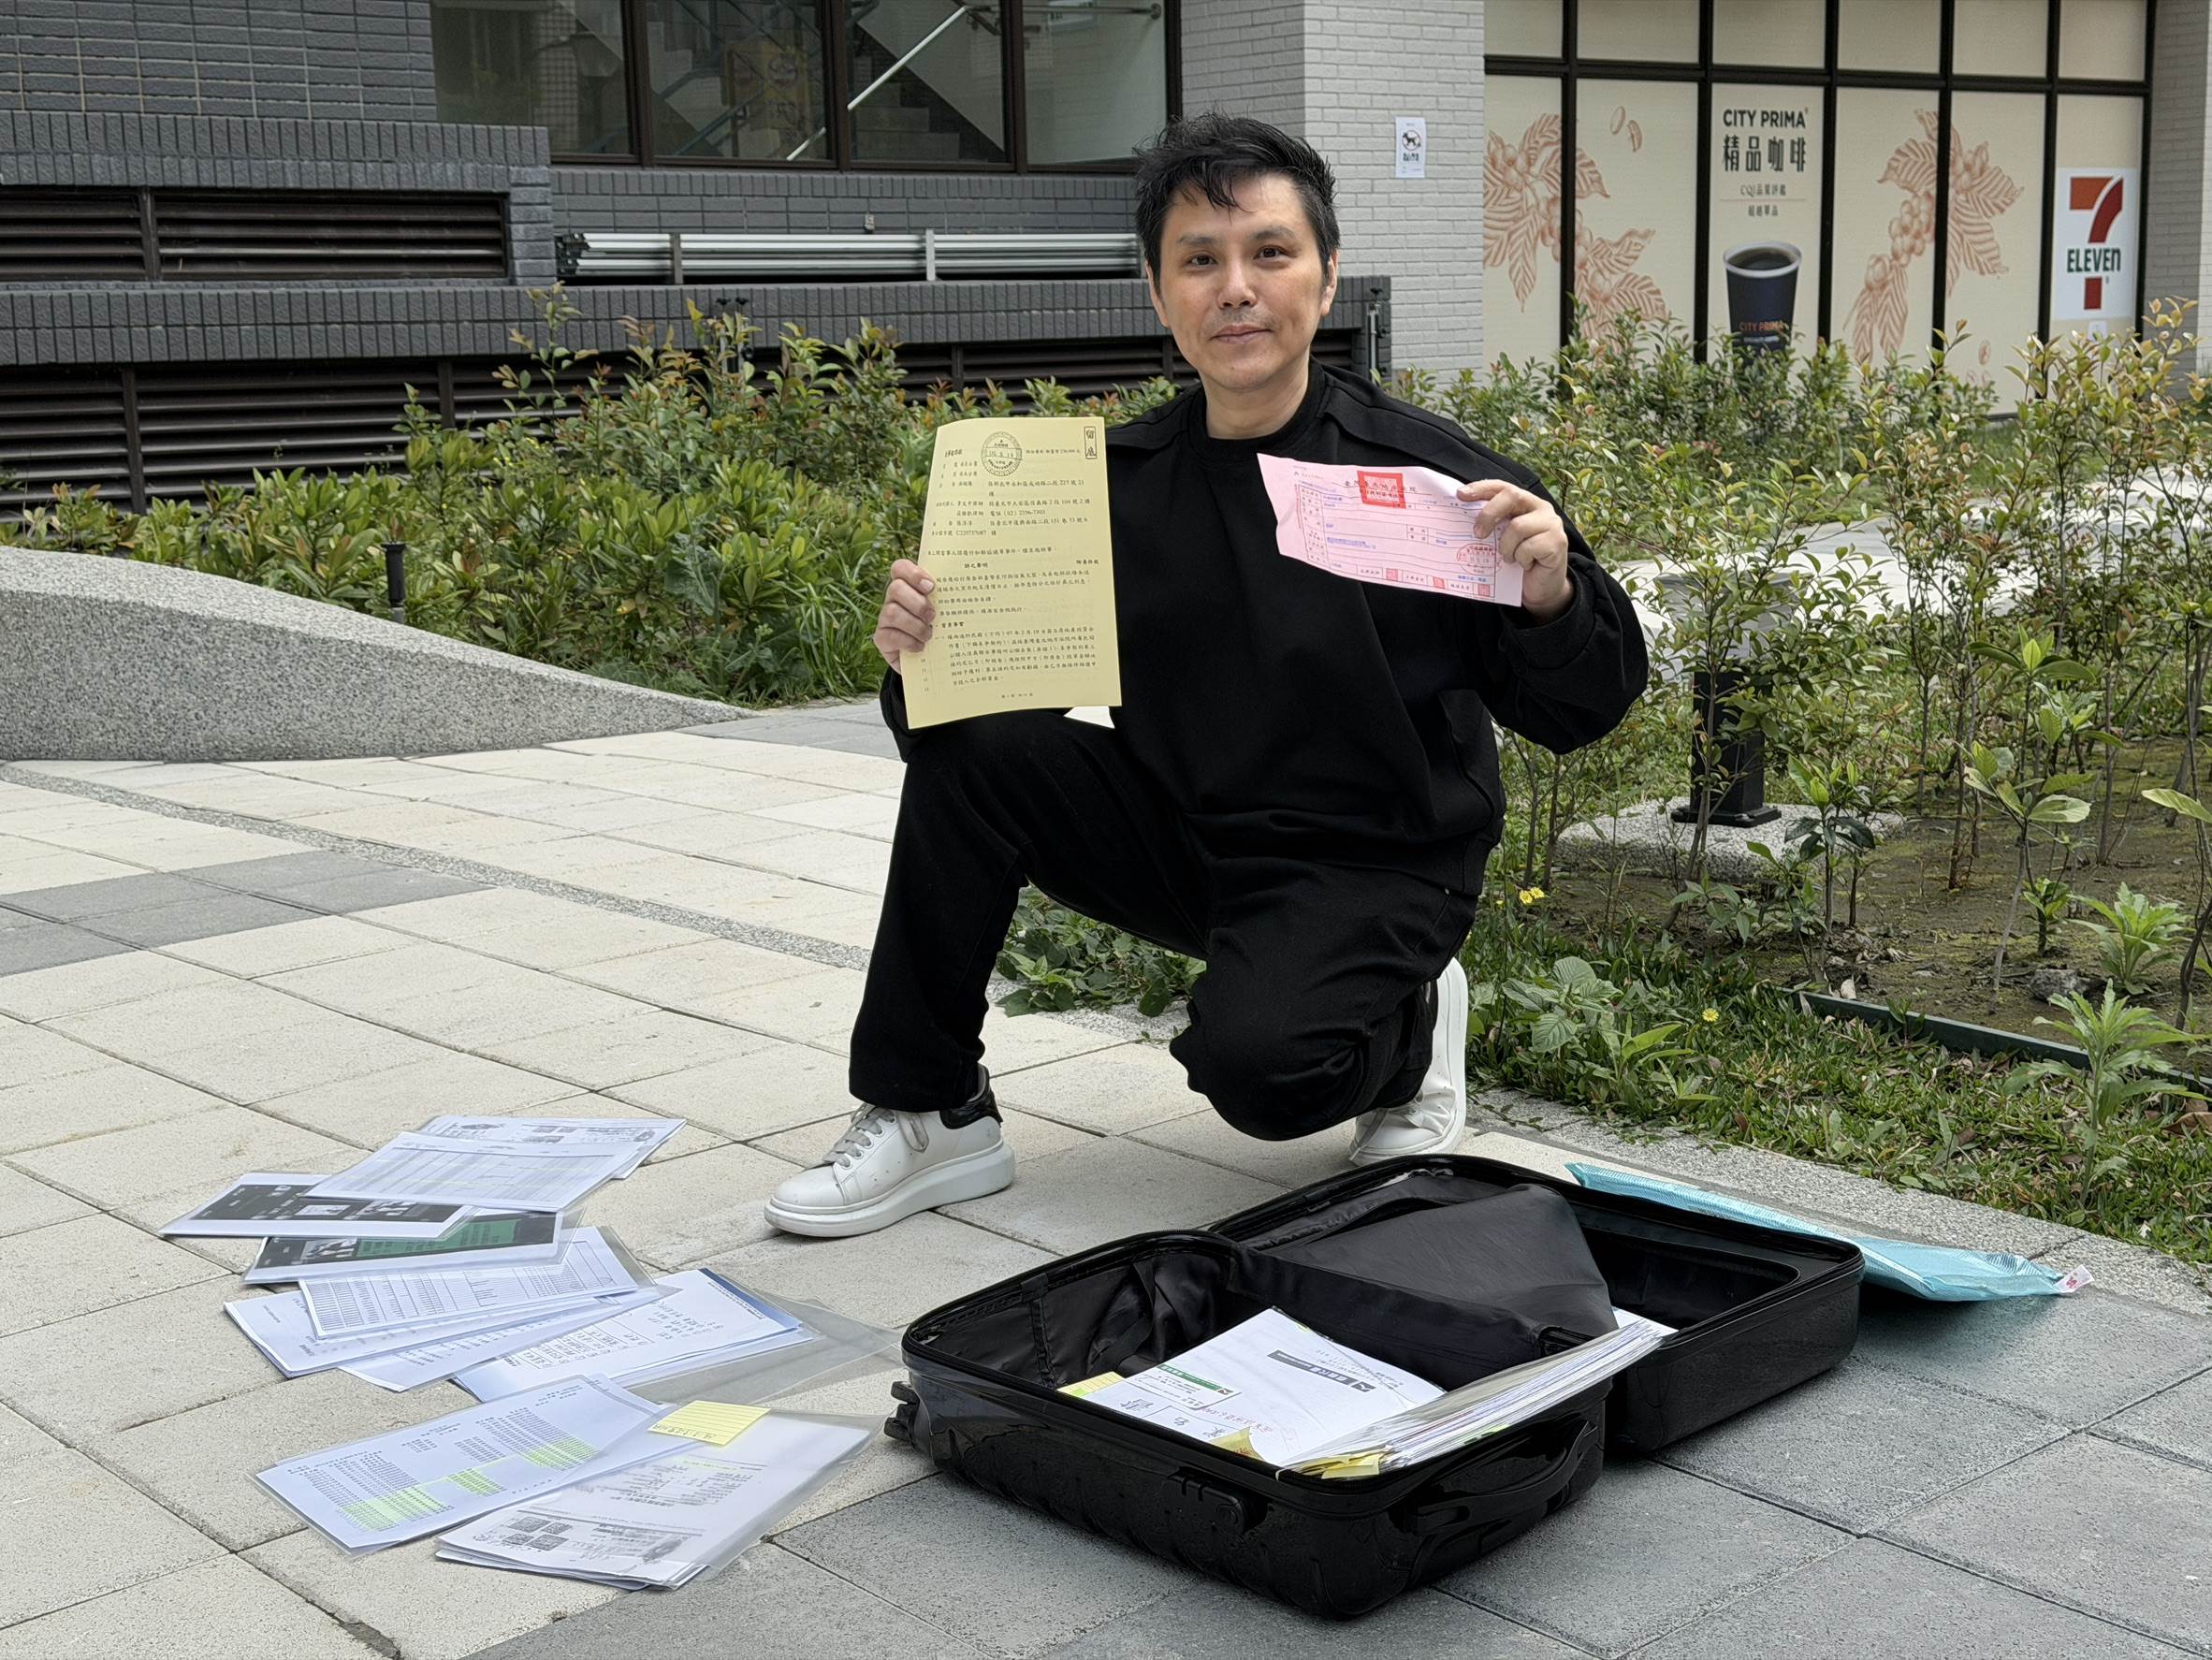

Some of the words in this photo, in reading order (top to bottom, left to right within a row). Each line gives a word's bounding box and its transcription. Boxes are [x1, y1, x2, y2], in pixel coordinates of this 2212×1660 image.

[1723, 109, 1756, 127] CITY
[1761, 110, 1806, 128] PRIMA
[1723, 135, 1806, 172] 精品咖啡
